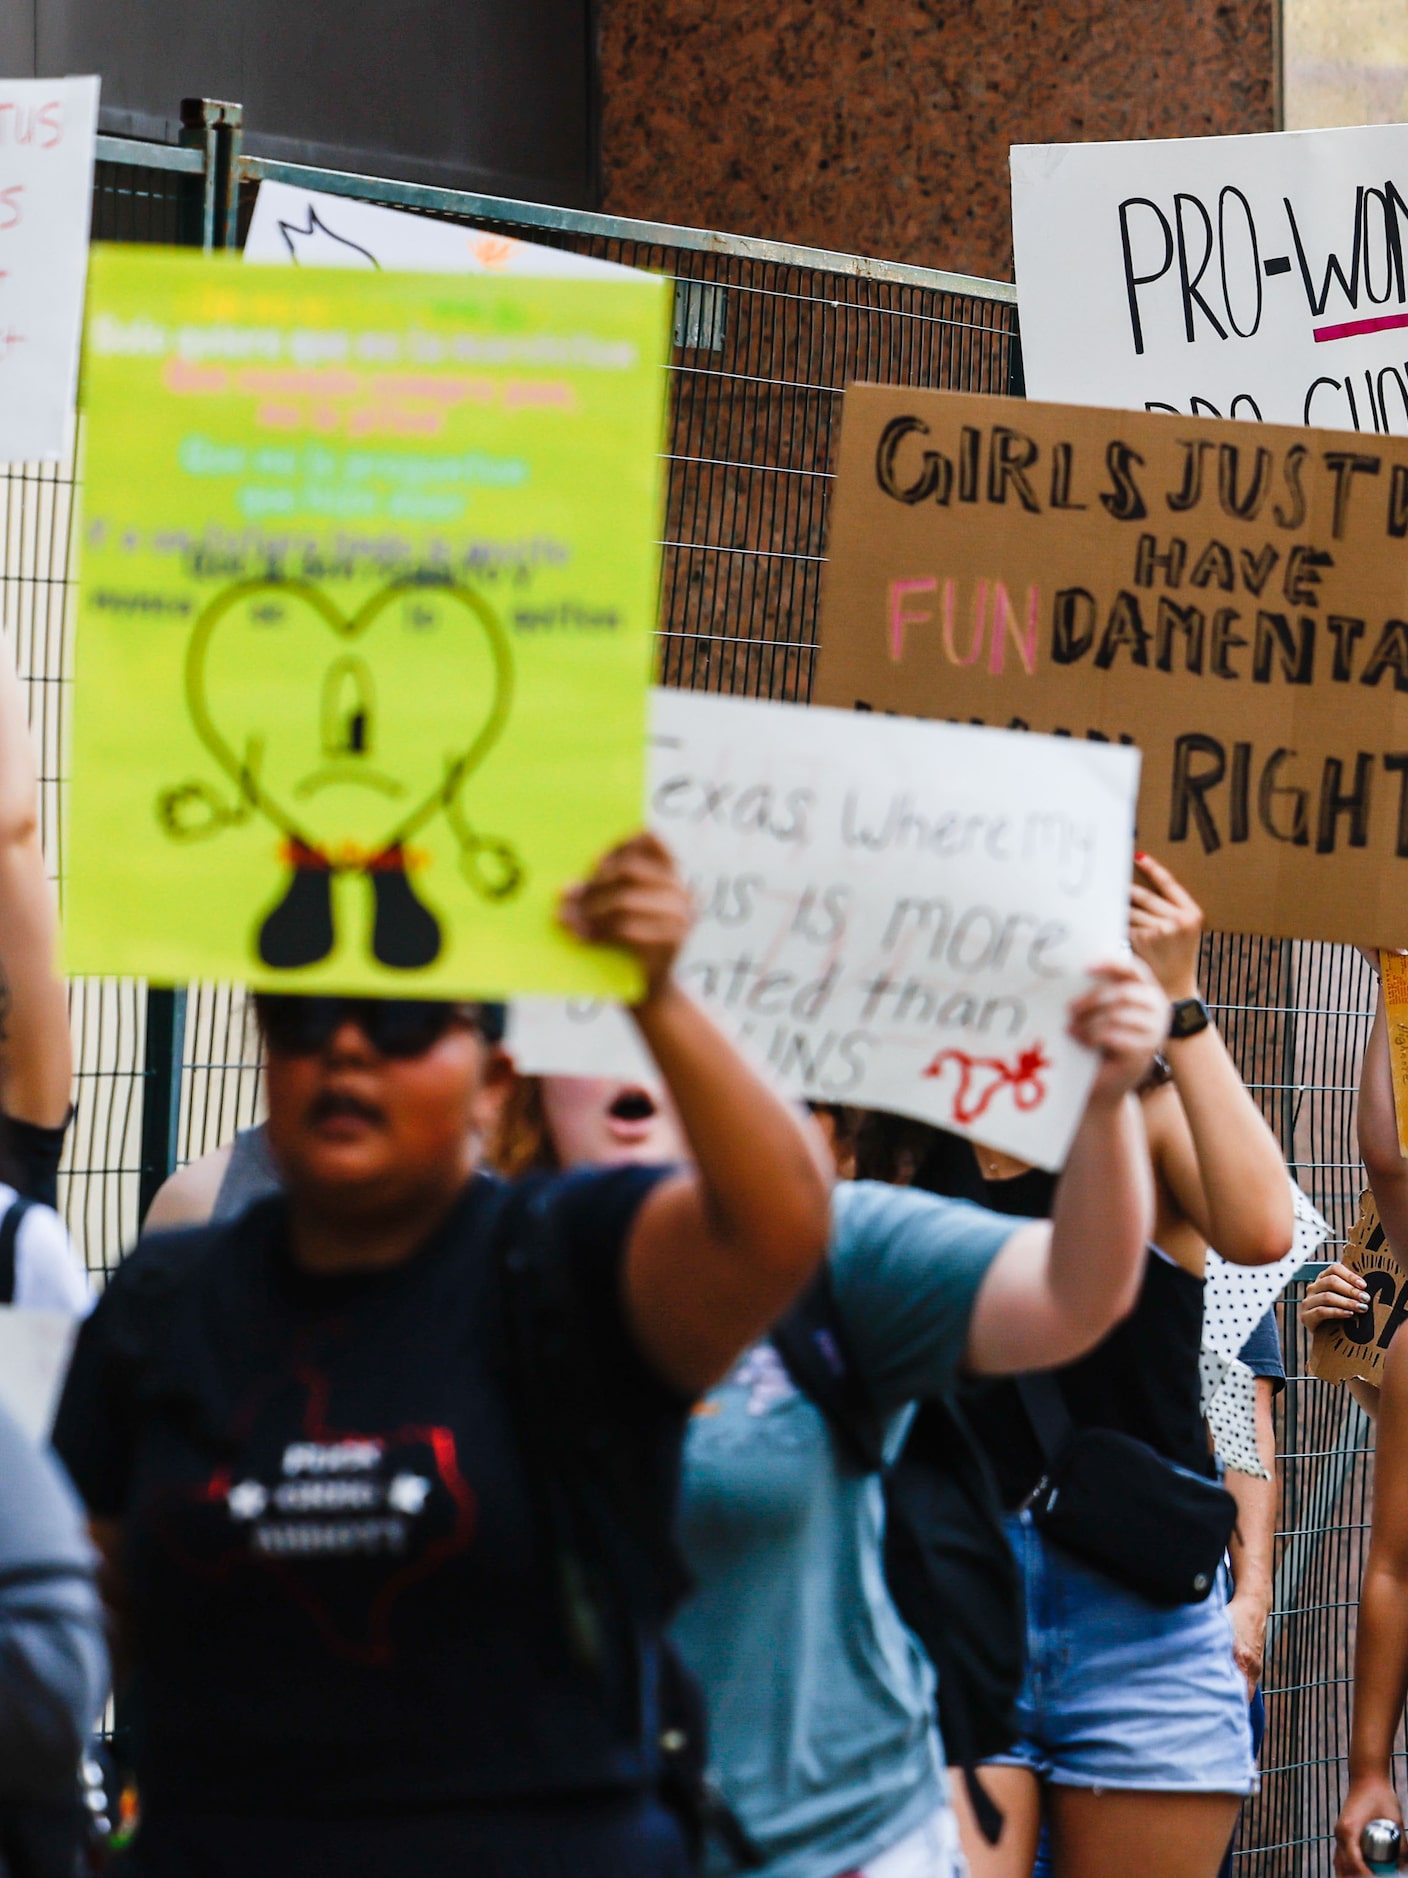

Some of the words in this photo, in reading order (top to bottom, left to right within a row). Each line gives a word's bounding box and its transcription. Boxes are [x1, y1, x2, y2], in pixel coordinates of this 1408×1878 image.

[876, 415, 1147, 521] GIRLS
[1166, 438, 1380, 541] JUST
[1133, 533, 1336, 608] HAVE
[645, 735, 816, 844] exas
